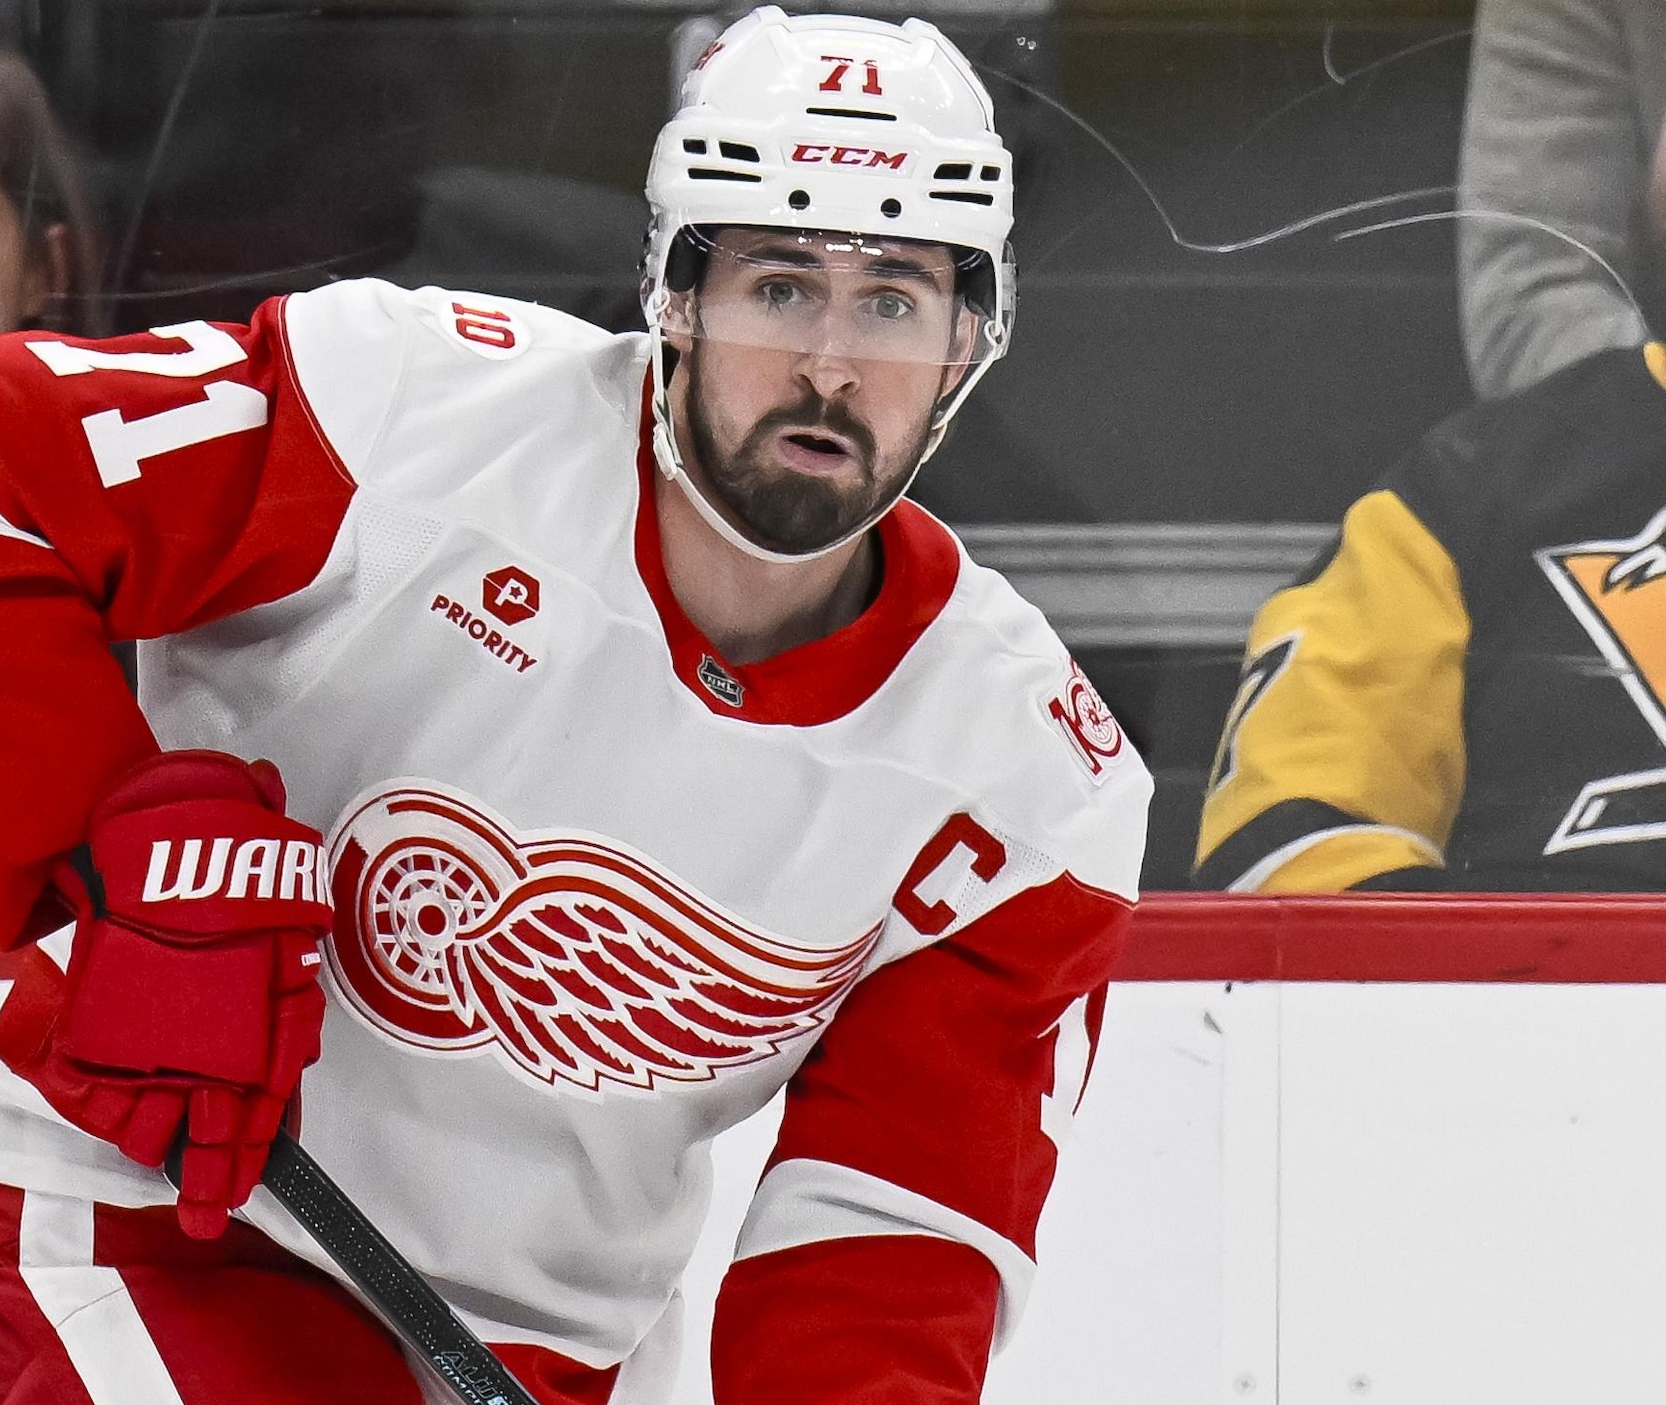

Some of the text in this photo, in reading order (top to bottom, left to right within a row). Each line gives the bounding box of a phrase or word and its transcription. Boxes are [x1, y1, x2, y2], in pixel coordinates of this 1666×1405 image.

[819, 55, 883, 95] 71
[791, 143, 908, 170] CCM
[451, 301, 515, 350] 10
[23, 319, 269, 489] 71
[430, 594, 538, 673] PRIORITY
[891, 811, 1008, 935] C
